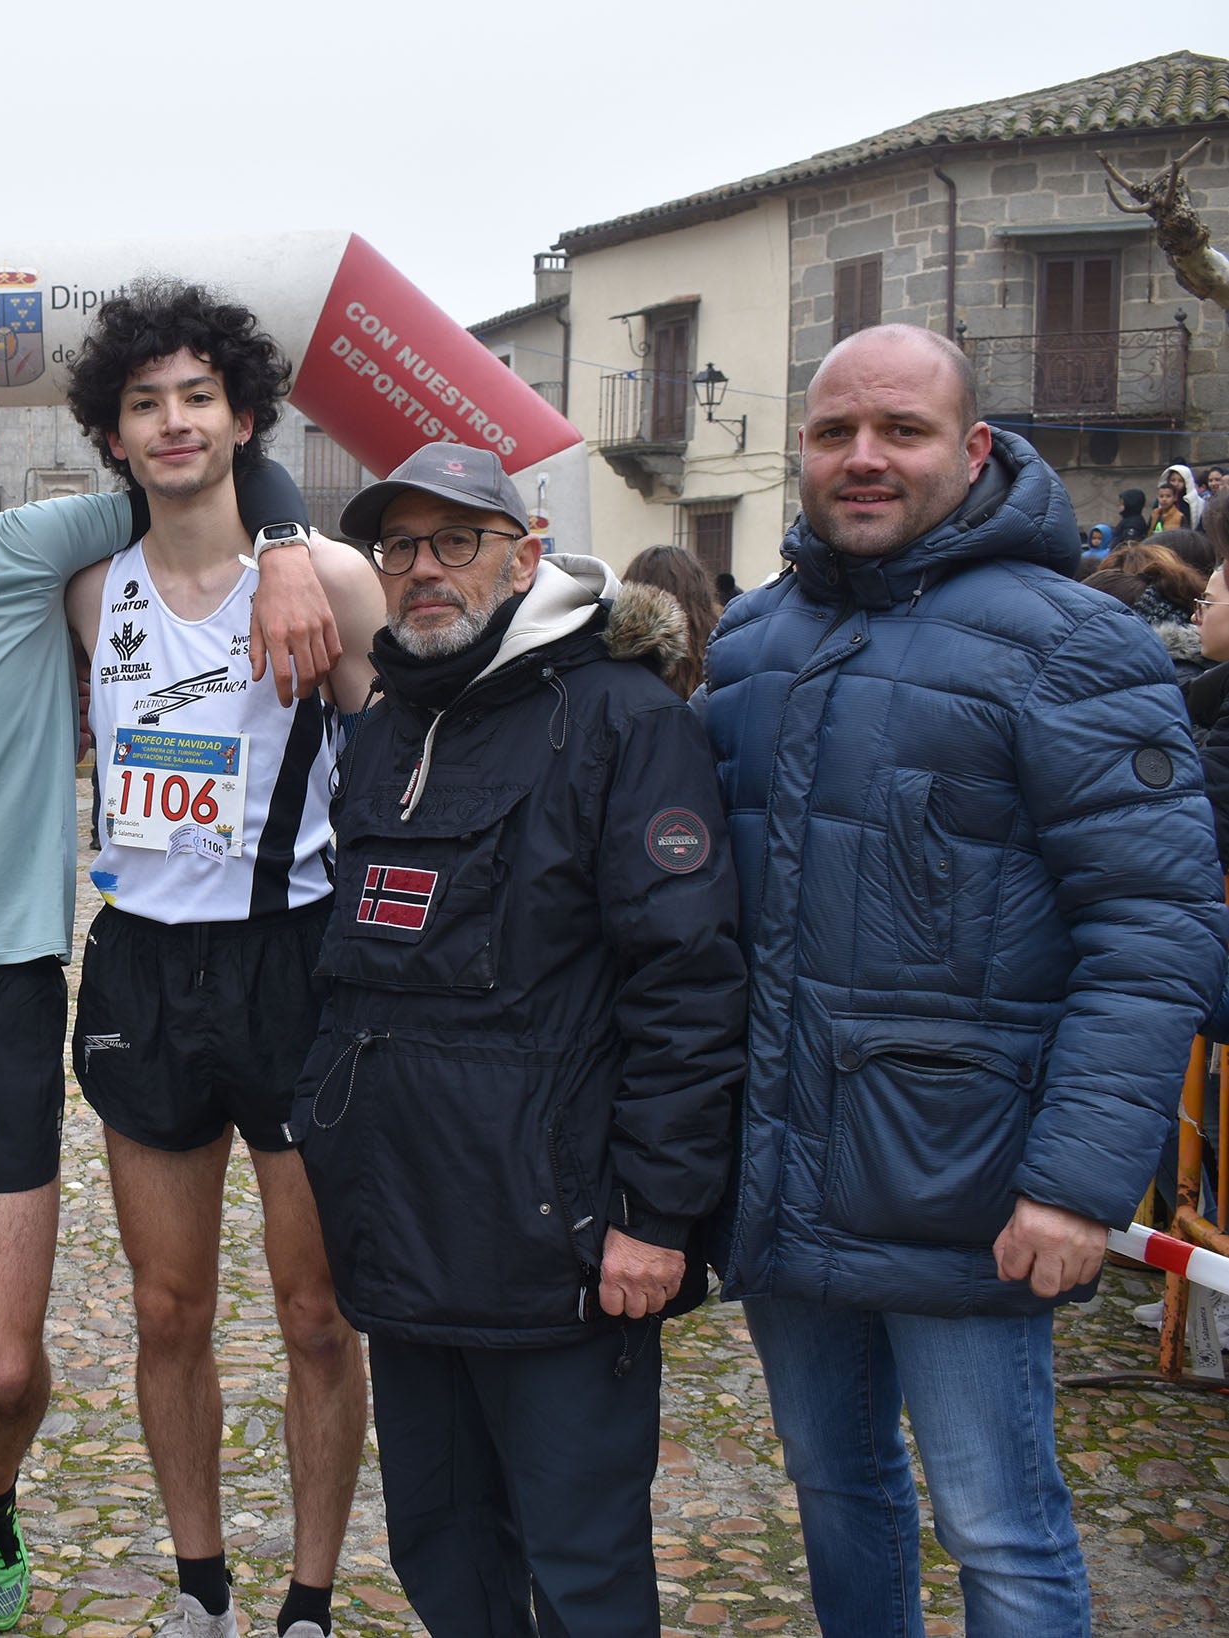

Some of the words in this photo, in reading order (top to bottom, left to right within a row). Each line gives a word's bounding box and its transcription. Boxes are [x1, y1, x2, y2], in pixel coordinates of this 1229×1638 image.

[51, 344, 76, 364] de
[345, 302, 399, 351] CON
[395, 345, 518, 456] NUESTROS
[330, 335, 469, 446] DEPORTIST
[111, 599, 149, 613] VIATOR
[230, 647, 241, 656] de
[120, 662, 152, 673] RURAL
[100, 677, 109, 685] DE
[111, 672, 151, 683] SALAMANCA
[132, 699, 168, 712] ATLÉTICO
[131, 734, 163, 745] TROFEO
[163, 737, 176, 747] DE
[178, 739, 222, 751] NAVIDAD
[173, 757, 213, 766] SALAMANCA
[119, 770, 219, 825] 1106
[114, 818, 140, 827] Diputación
[118, 830, 144, 838] Salamanca
[202, 838, 224, 856] 1106
